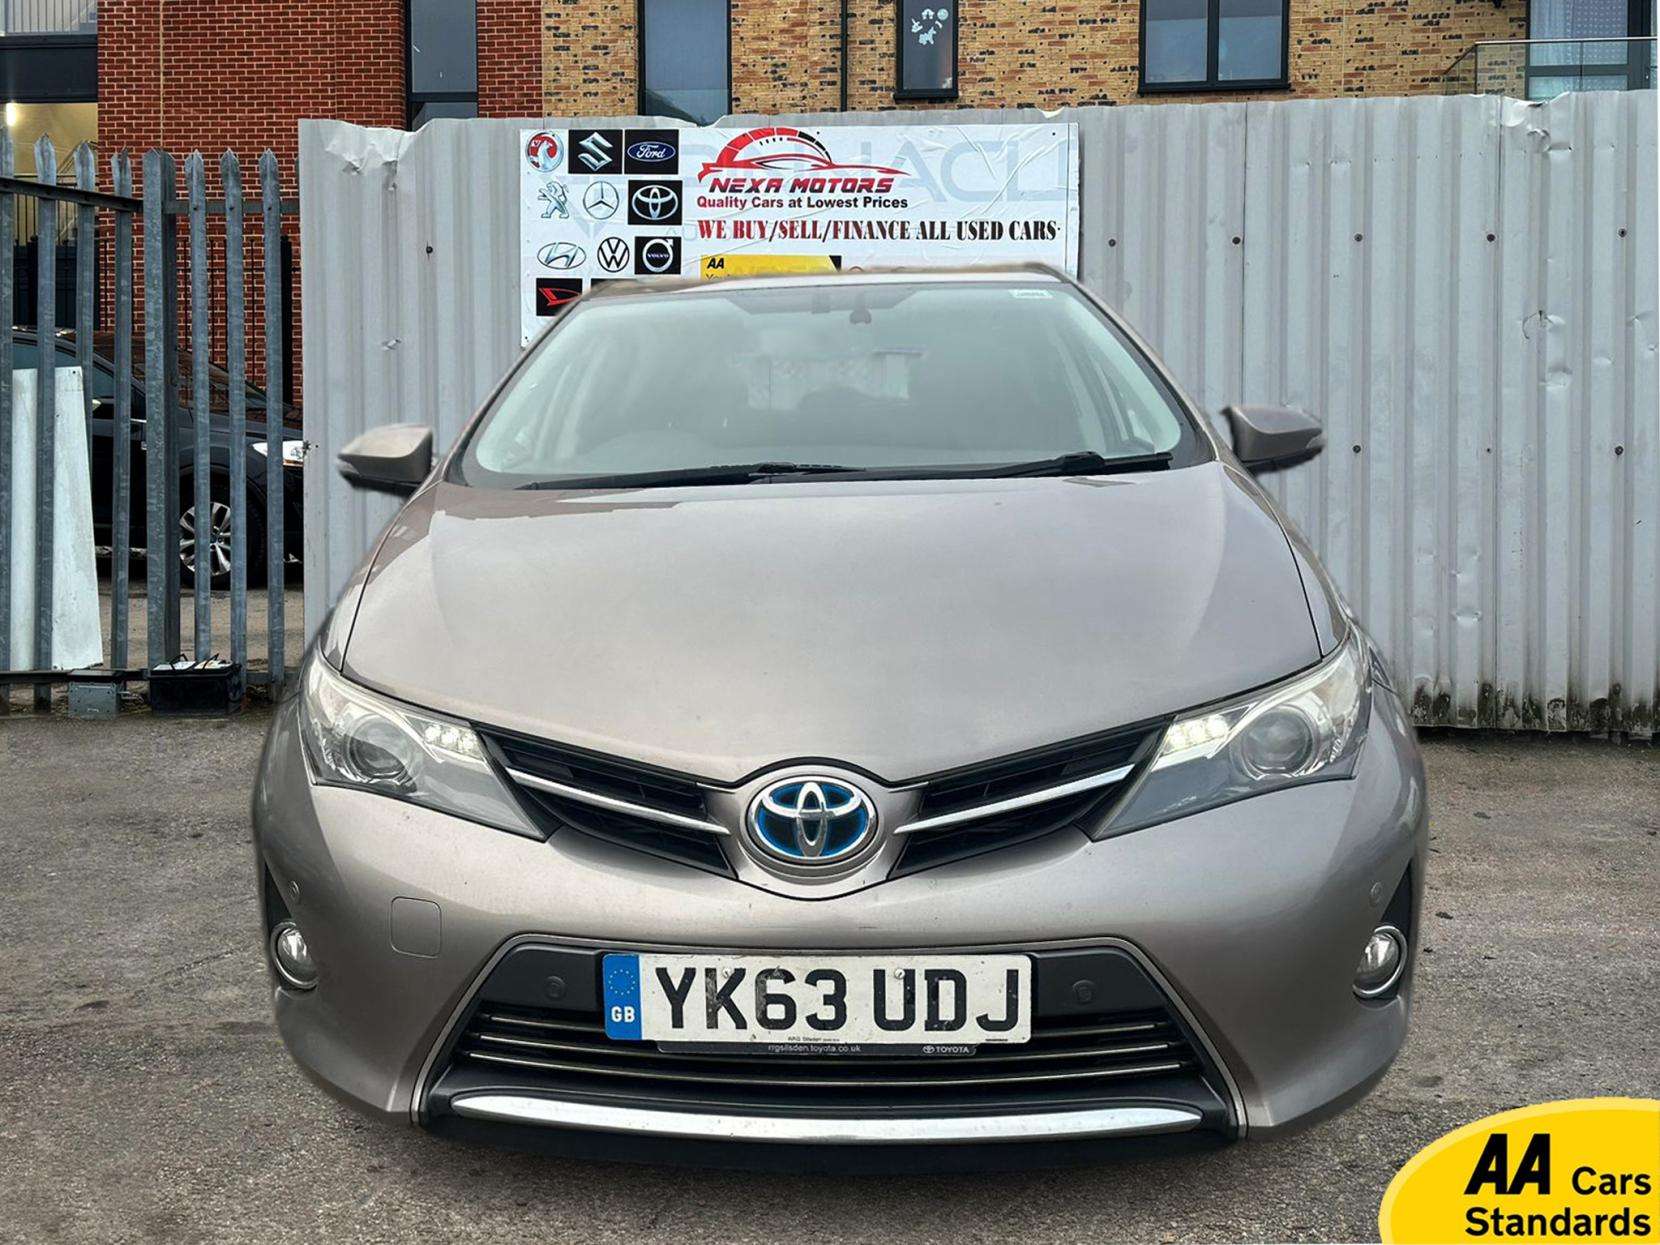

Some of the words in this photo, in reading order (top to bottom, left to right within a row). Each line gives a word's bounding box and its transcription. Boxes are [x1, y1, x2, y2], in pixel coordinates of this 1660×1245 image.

[635, 144, 666, 159] Ford
[708, 177, 782, 194] NEXA
[788, 177, 895, 194] MOTORS
[697, 195, 747, 210] Quality
[751, 195, 785, 209] Cars
[788, 196, 803, 209] at
[806, 196, 855, 209] Lowest
[862, 196, 909, 209] Prices
[697, 219, 728, 240] WE
[915, 219, 951, 241] ALL
[956, 219, 1004, 241] USED
[1008, 219, 1057, 241] CARS
[706, 257, 725, 269] AA
[655, 967, 848, 1031] YK63
[872, 968, 1020, 1032] UDJ
[611, 1006, 635, 1023] GB
[935, 1046, 970, 1054] TOYOTA
